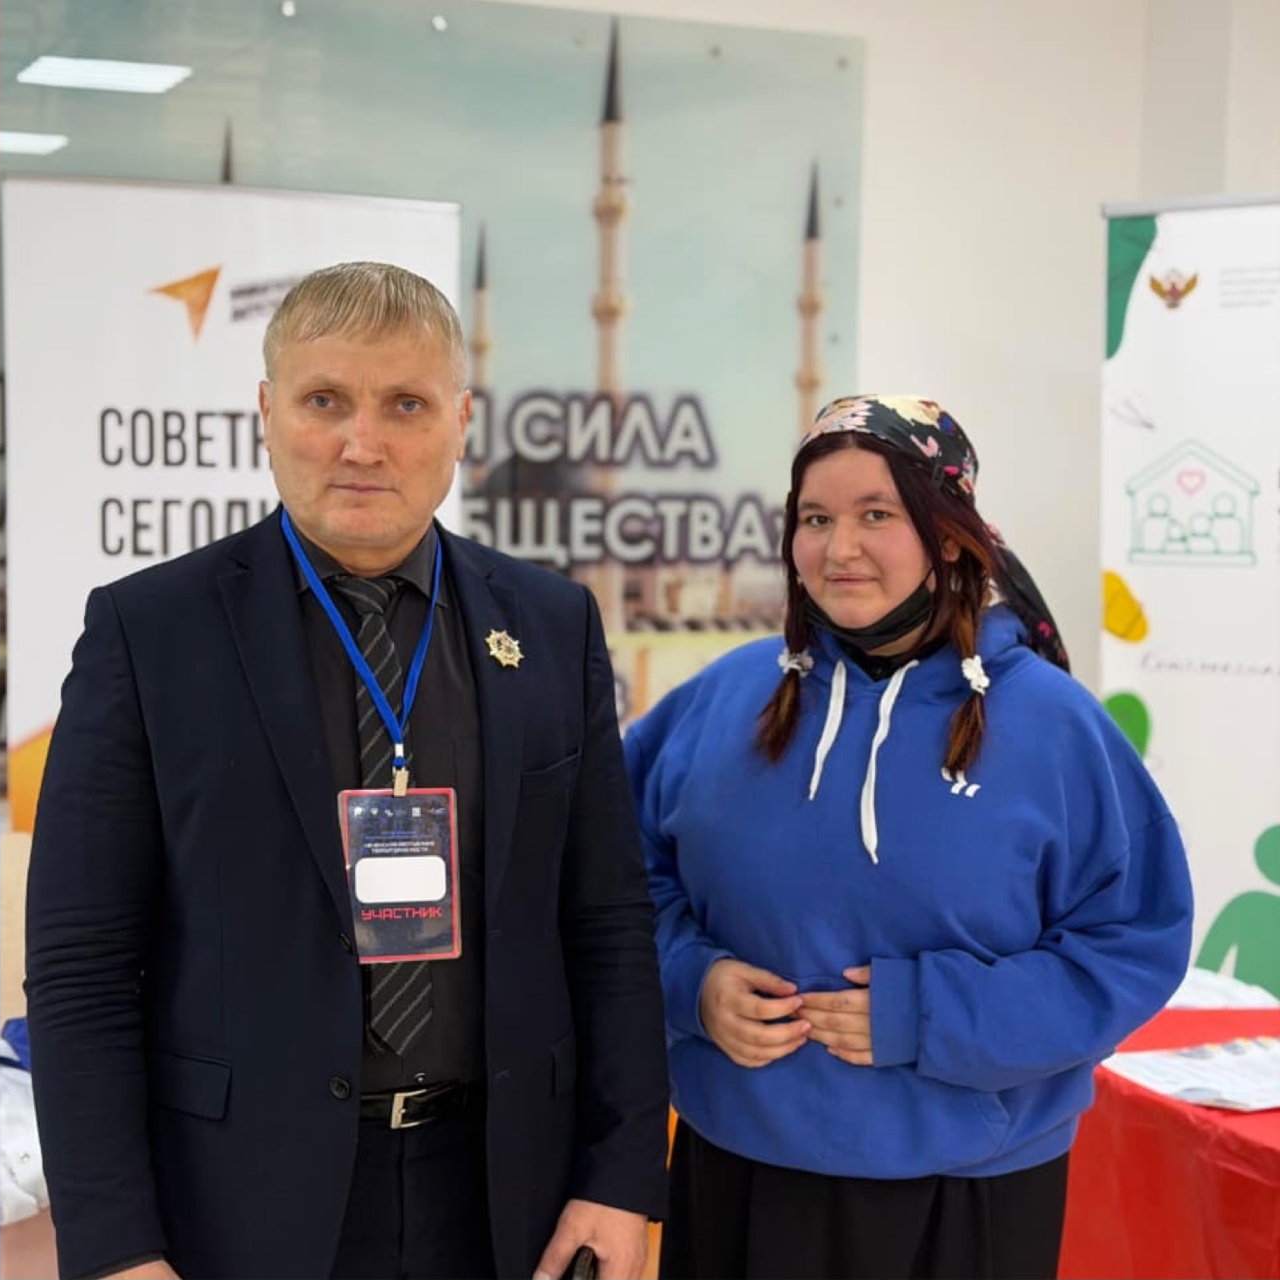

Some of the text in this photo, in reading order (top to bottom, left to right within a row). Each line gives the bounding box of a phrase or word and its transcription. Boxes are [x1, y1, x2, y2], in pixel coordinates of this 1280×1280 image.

[510, 398, 711, 464] СИЛА
[101, 497, 268, 557] СЕГОД
[361, 906, 443, 921] УЧАСТНИК
